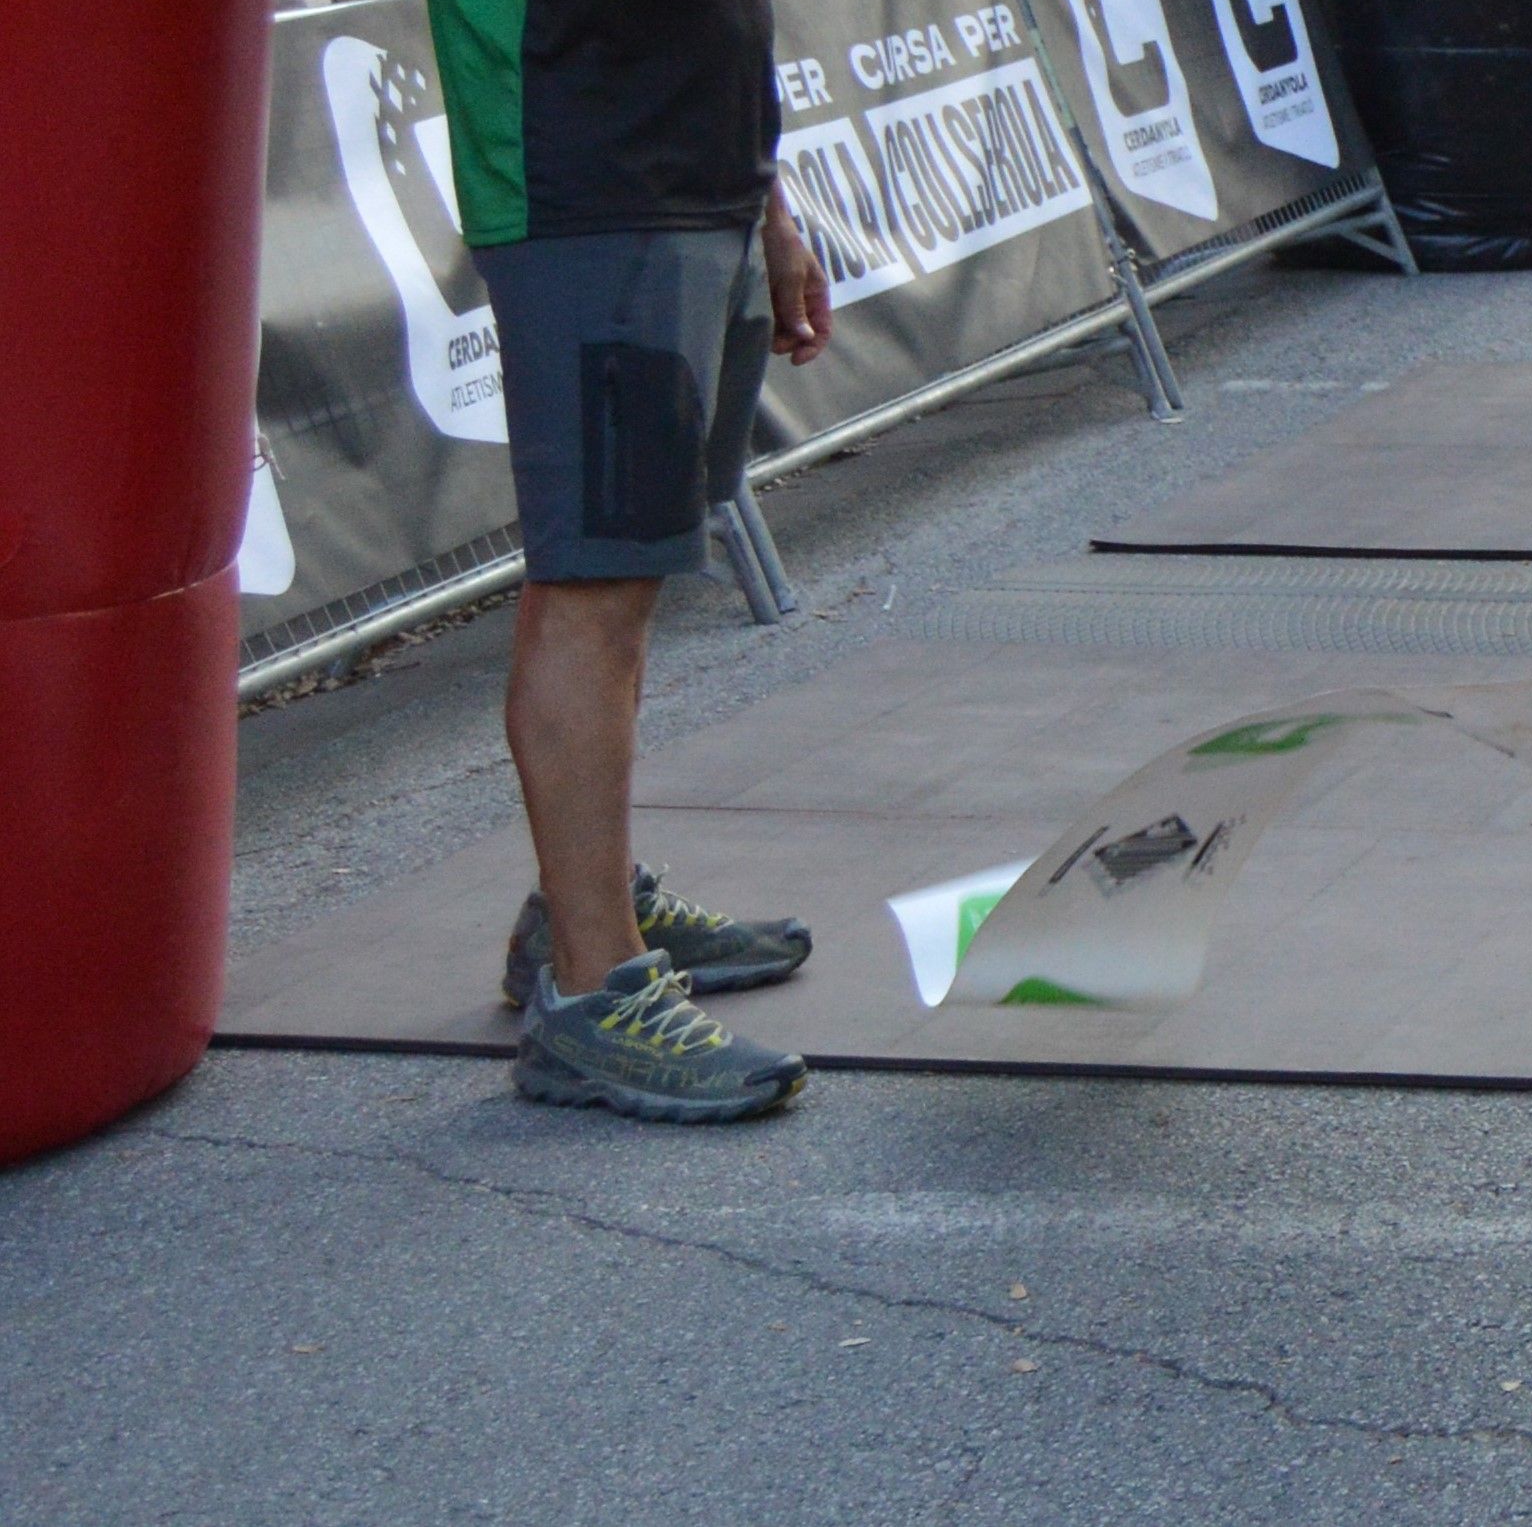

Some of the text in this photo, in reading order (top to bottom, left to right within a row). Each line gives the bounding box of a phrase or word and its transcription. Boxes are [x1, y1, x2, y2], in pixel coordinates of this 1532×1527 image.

[850, 3, 1022, 90] CURSA PER
[884, 78, 1081, 252] COLLSEROLA
[448, 322, 501, 370] CERDA
[451, 370, 503, 413] ATLETISM
